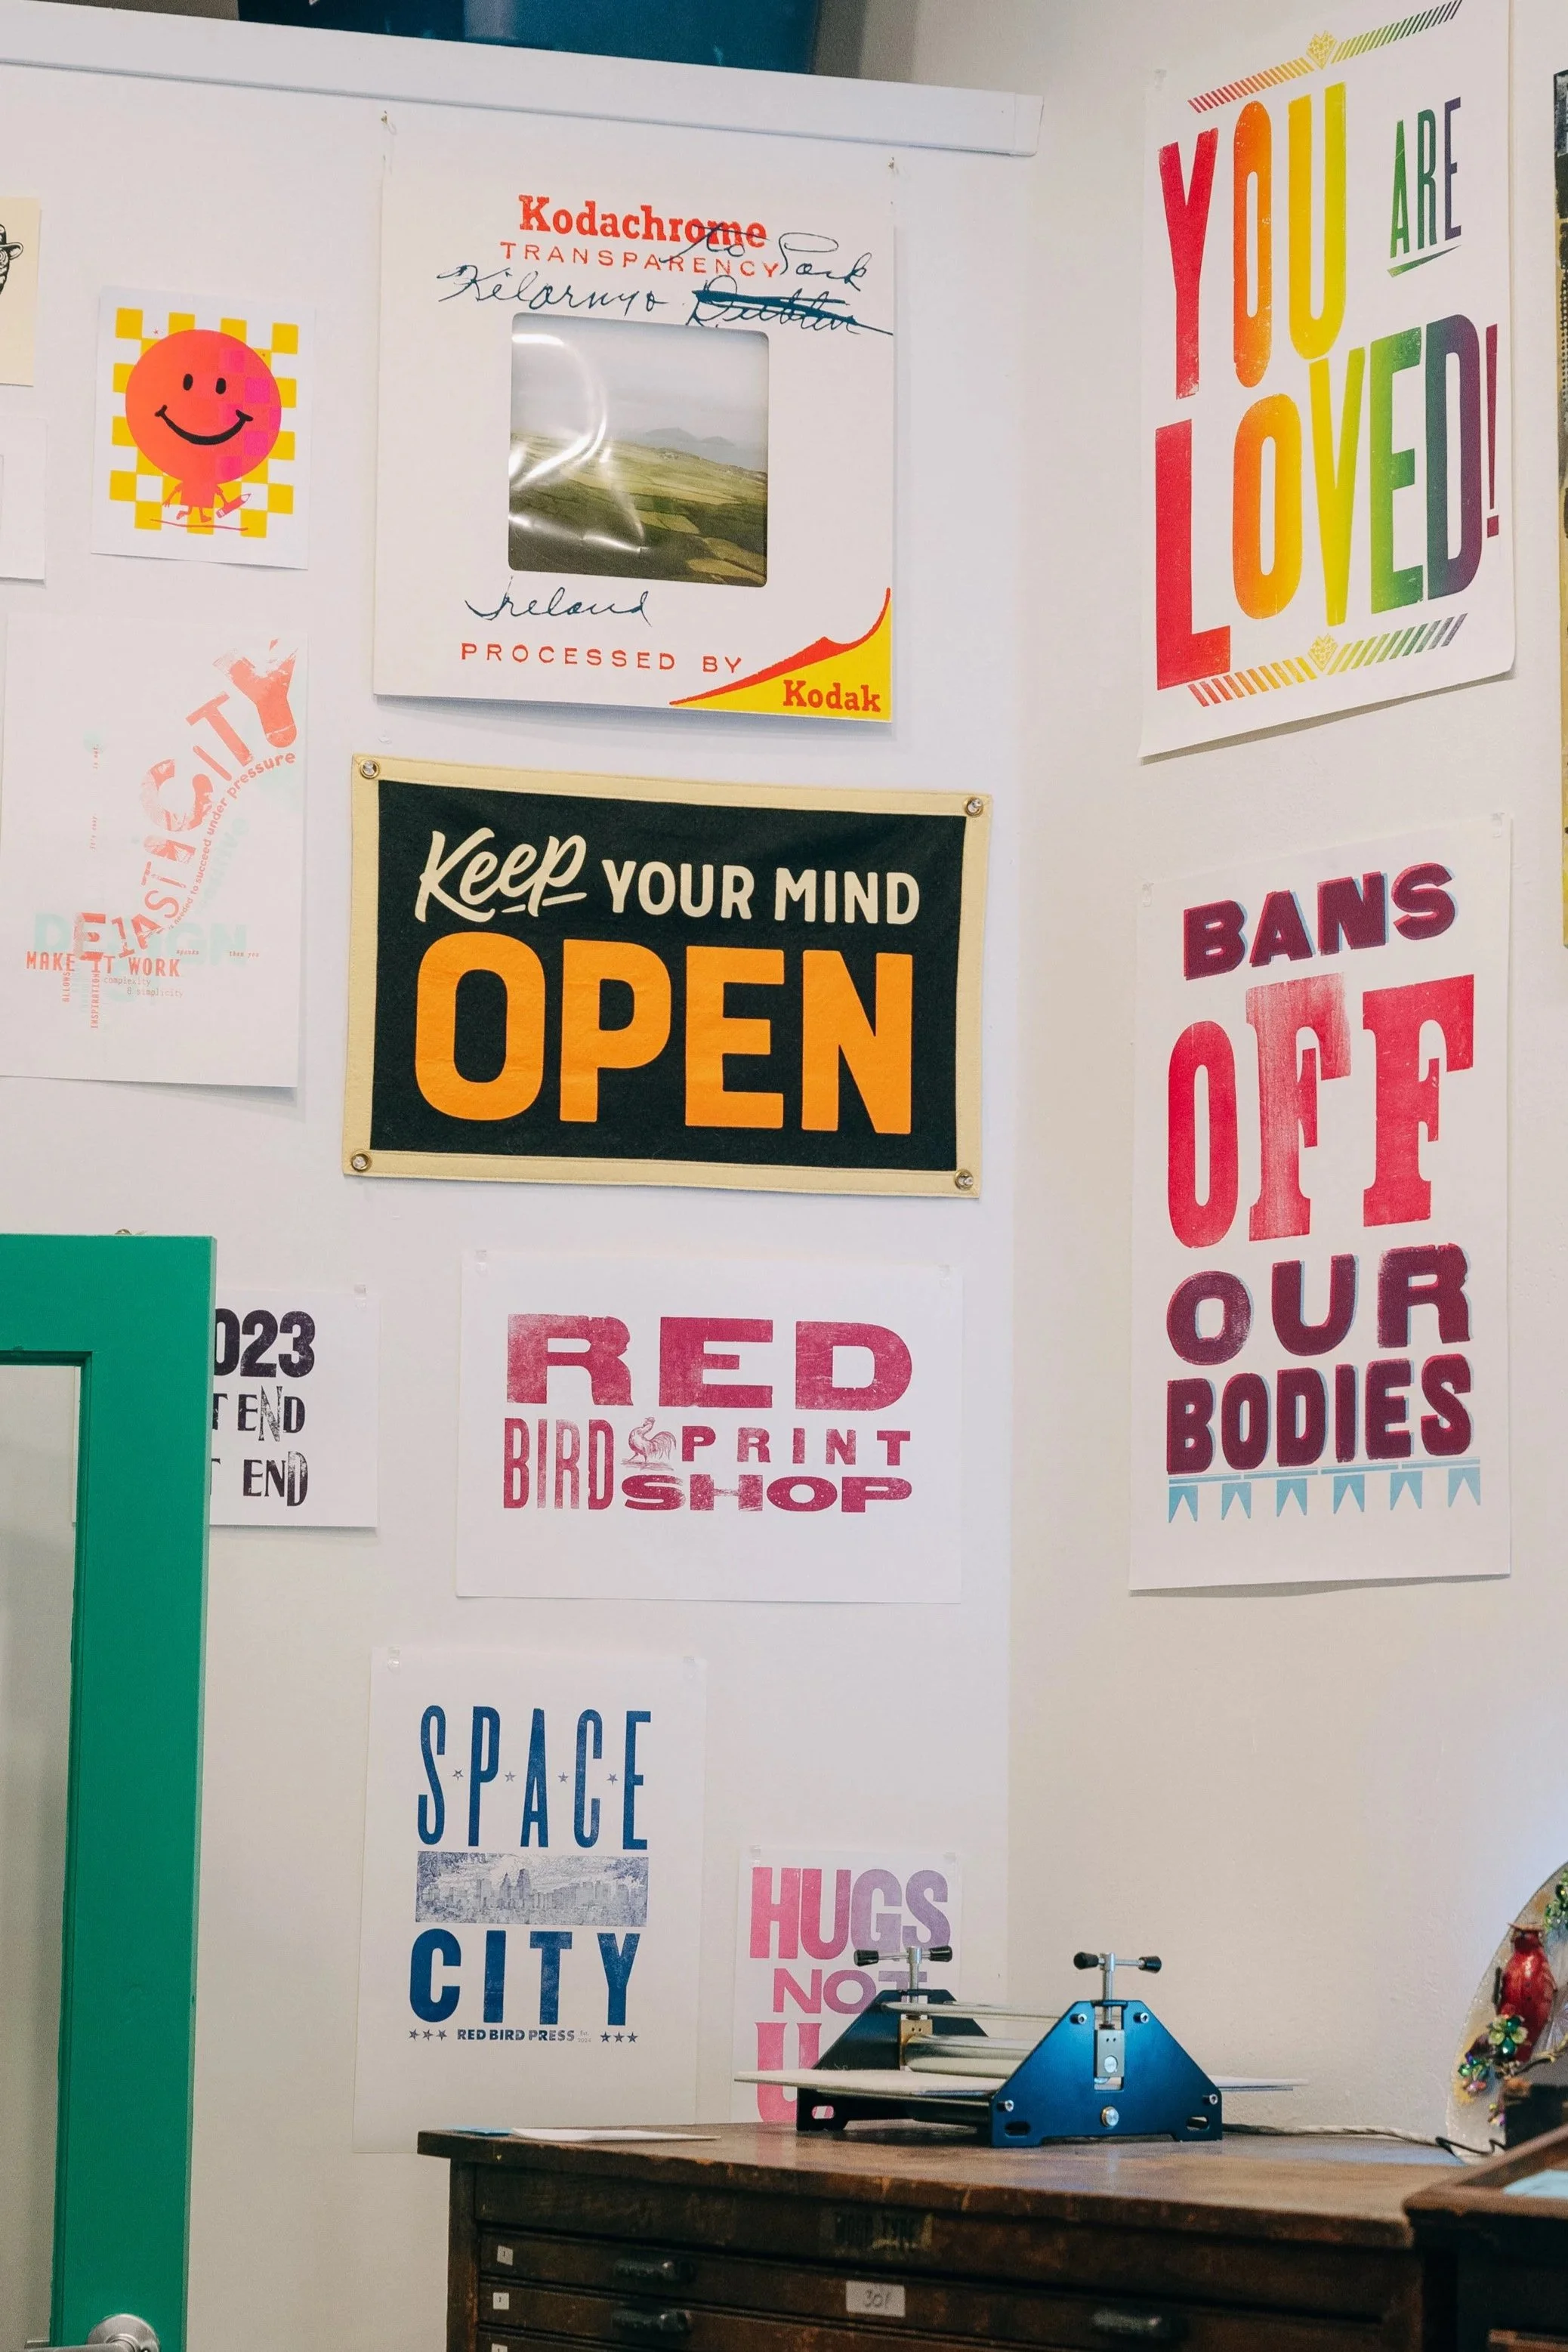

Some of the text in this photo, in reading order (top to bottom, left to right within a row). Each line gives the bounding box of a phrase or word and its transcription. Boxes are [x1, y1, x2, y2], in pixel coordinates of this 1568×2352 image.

[500, 242, 779, 277] TRANSPARENCY
[519, 195, 767, 248] Kodachrome
[1159, 82, 1462, 400] YOU ARE
[1156, 313, 1499, 690] LOVED!
[465, 576, 652, 627] Ireland
[461, 642, 742, 674] PROCESSED BY
[783, 680, 881, 711] Kodak
[174, 897, 193, 925] needed
[190, 885, 199, 895] to
[196, 838, 212, 884] succeed
[207, 798, 227, 835] under
[227, 752, 296, 799] pressure
[415, 827, 920, 925] Keep YOUR MIND
[26, 951, 76, 971] MAKE
[128, 957, 181, 977] WORK
[1184, 863, 1458, 980] BANS
[90, 974, 100, 1029] INSPIRATION
[103, 977, 152, 987] complexity
[137, 988, 184, 998] simplicity
[415, 931, 913, 1134] OPEN
[1168, 971, 1474, 1248] OFF
[1166, 1242, 1474, 1366] OUR
[507, 1313, 912, 1411] RED
[238, 1385, 305, 1442] END
[1166, 1353, 1475, 1475] BODIES
[242, 1451, 308, 1506] END
[503, 1418, 911, 1510] BIRD PRINT
[622, 1474, 912, 1512] SHOP
[418, 1705, 651, 1850] SPACE
[750, 1866, 951, 1959] HUGS
[409, 1928, 640, 2026] CITY
[457, 2029, 576, 2042] RED BIRD PRESS
